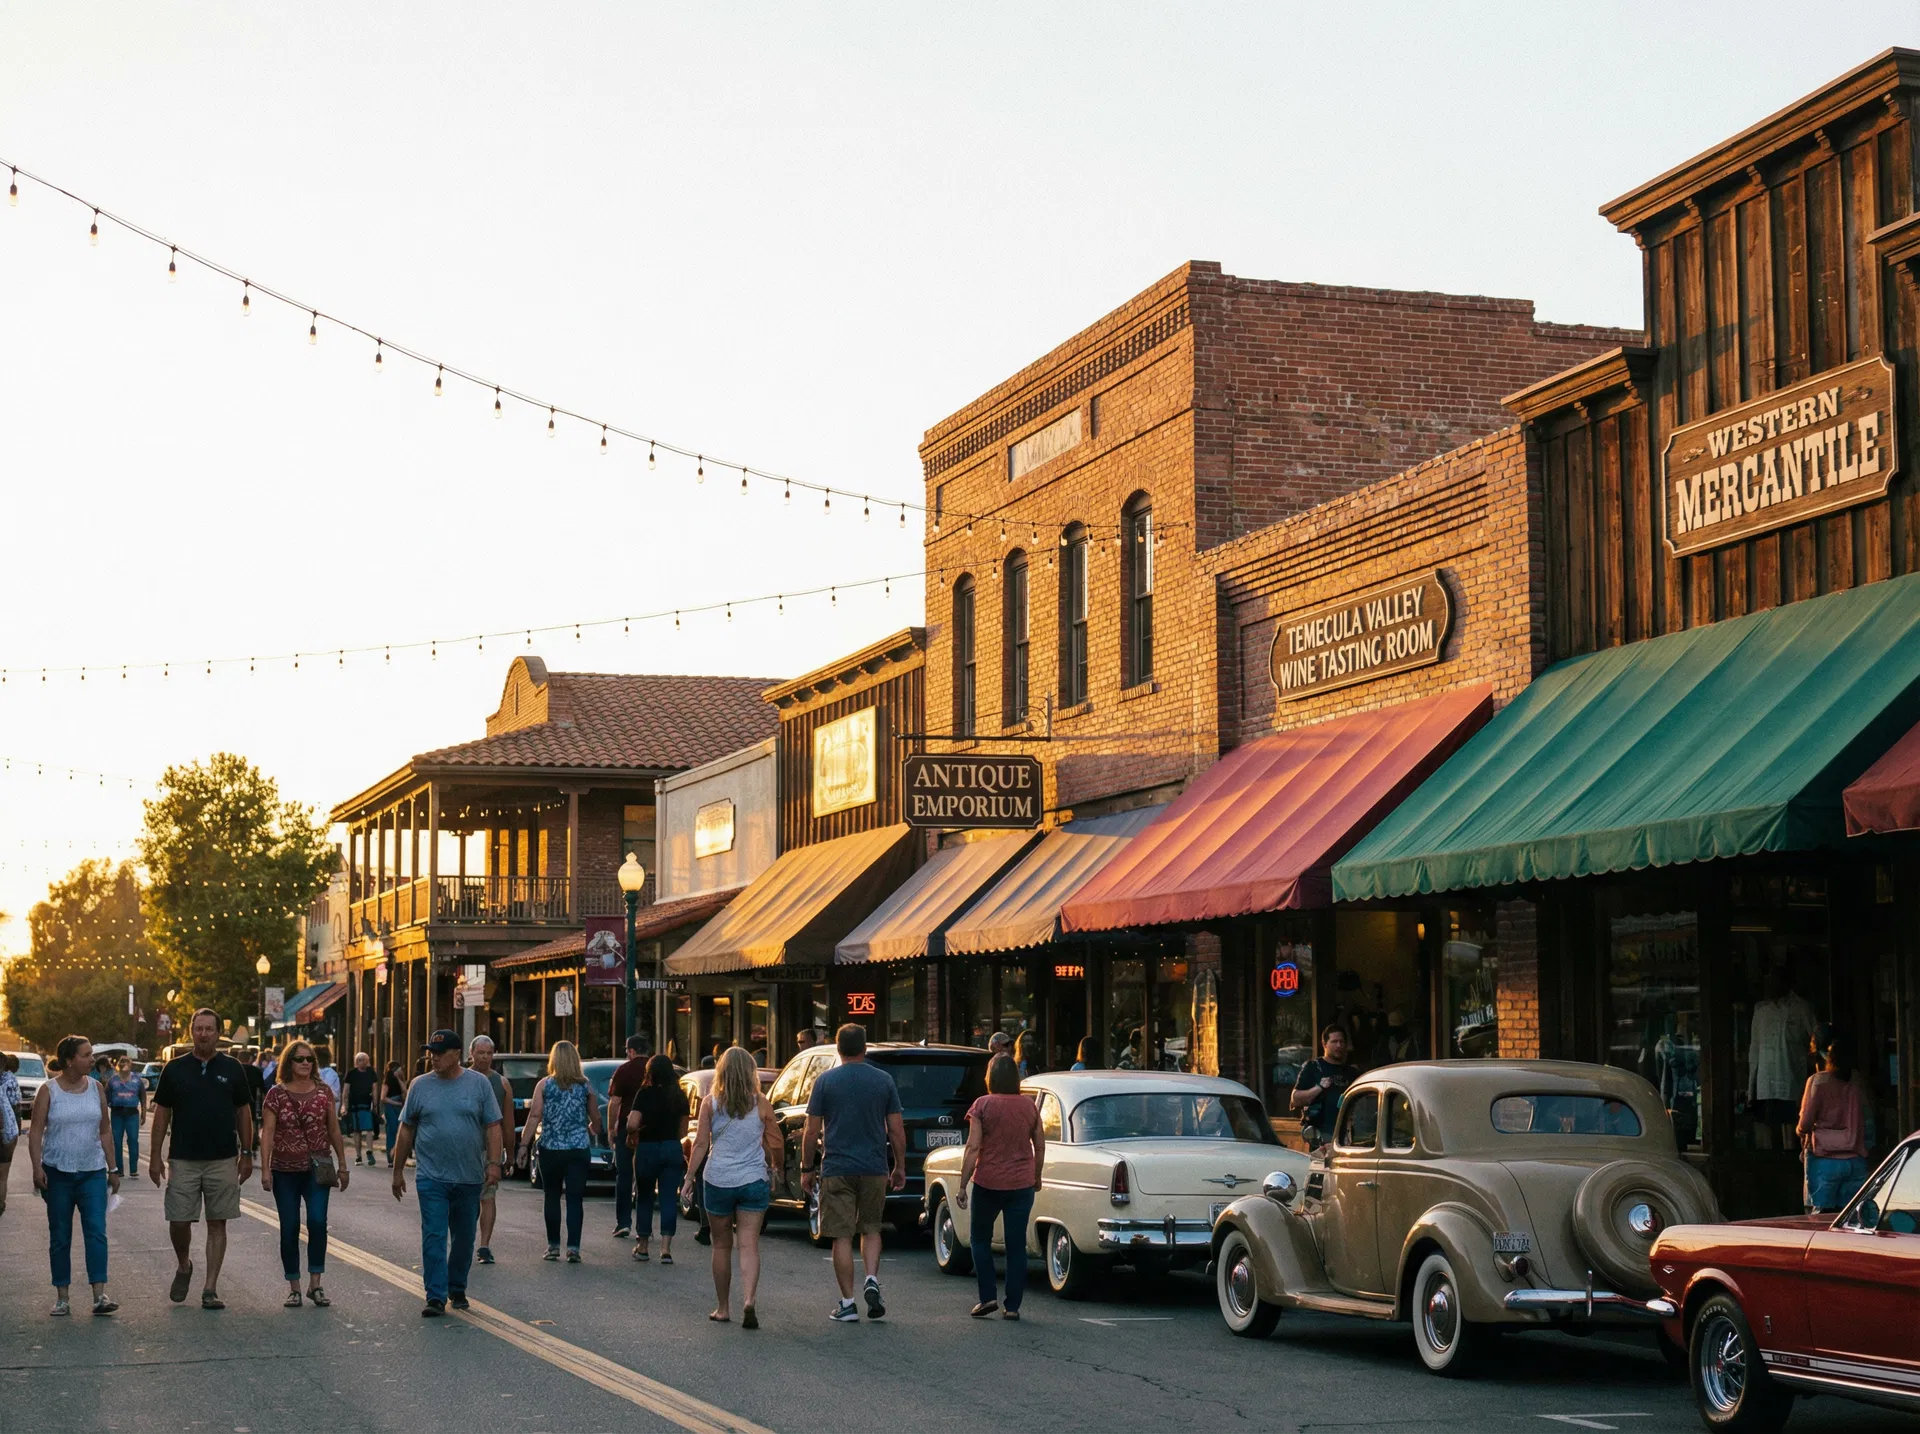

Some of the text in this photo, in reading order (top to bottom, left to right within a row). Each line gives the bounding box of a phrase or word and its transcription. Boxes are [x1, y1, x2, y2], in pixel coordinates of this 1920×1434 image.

[1706, 386, 1840, 459] WESTERN
[1675, 411, 1881, 535] MERCANTILE
[1280, 619, 1434, 690] WINE TASTING ROOM
[1286, 585, 1424, 655] TEMECULA VALLEY
[912, 795, 1033, 818] EMPORIUM
[913, 763, 1032, 793] ANTIQUE
[1270, 968, 1299, 990] OPEN
